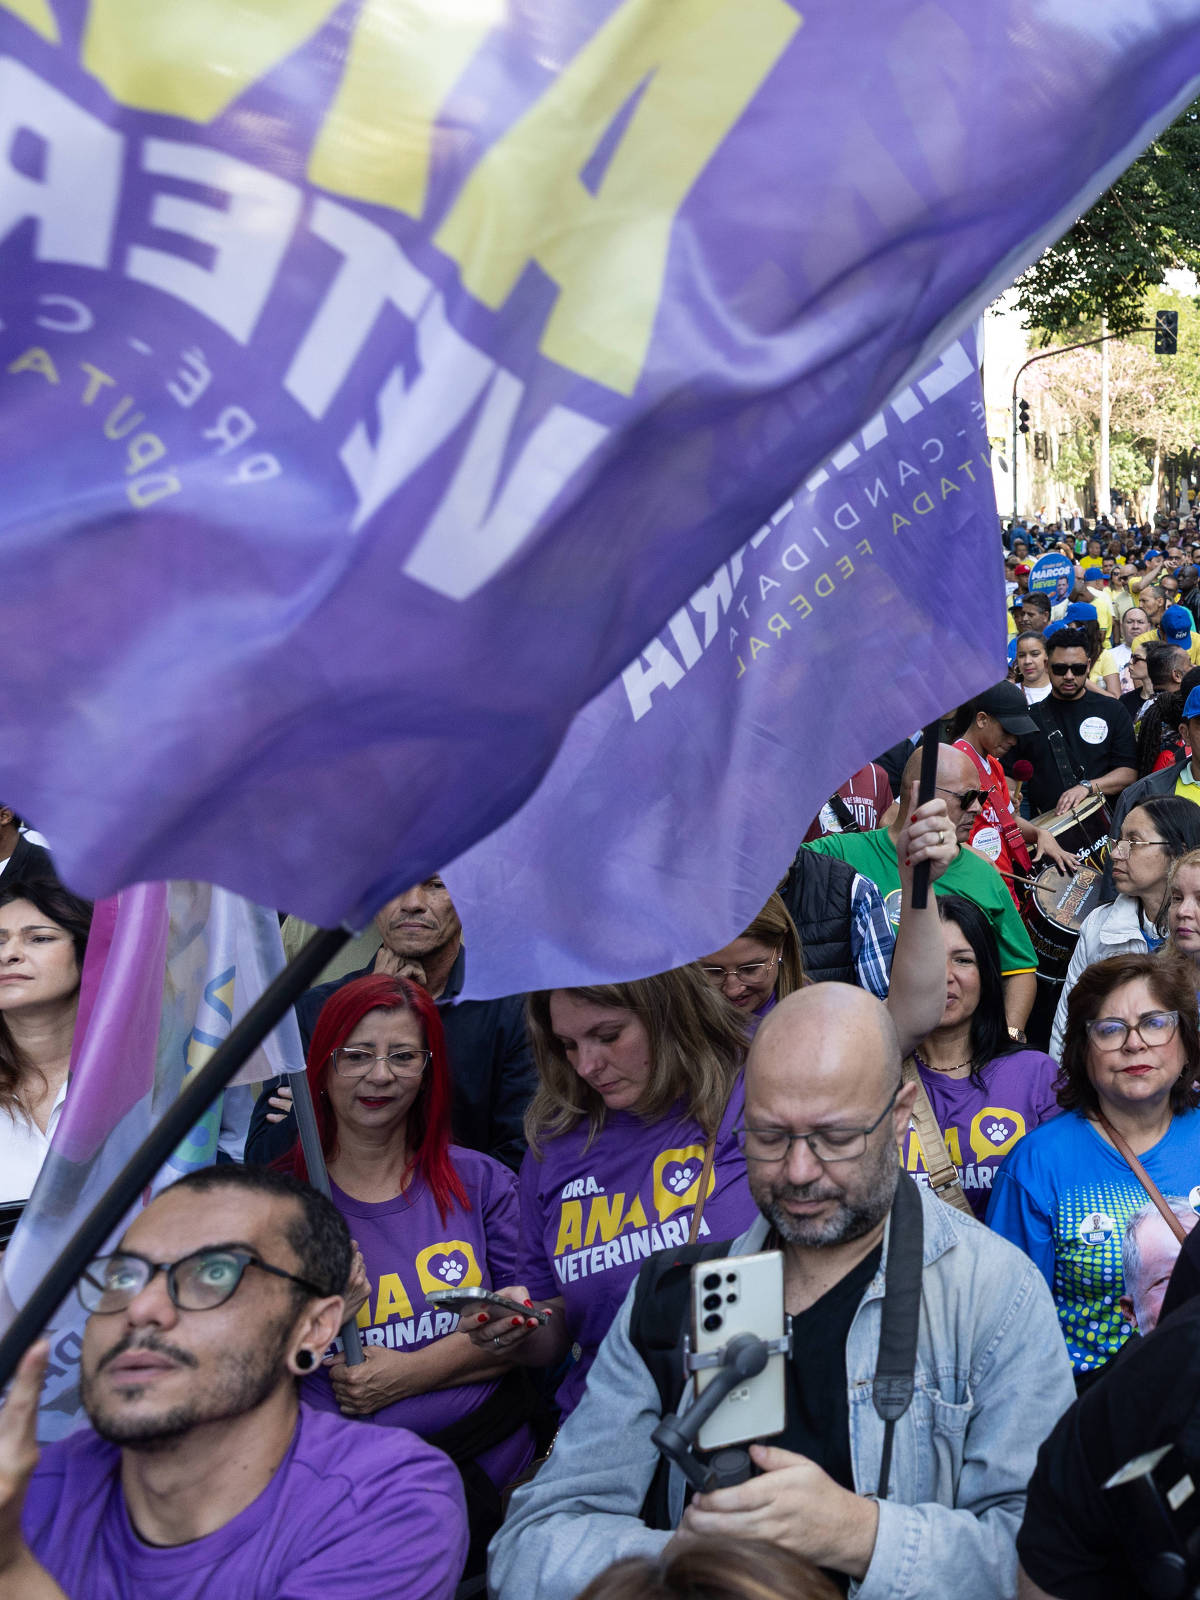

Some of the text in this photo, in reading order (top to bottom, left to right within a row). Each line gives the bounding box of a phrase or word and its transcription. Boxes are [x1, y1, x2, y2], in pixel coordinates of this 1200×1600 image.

[1032, 566, 1071, 580] MARCOS
[561, 1176, 605, 1199] DRA.
[554, 1192, 648, 1257] ANA
[554, 1213, 712, 1285] VETERINÁRIA
